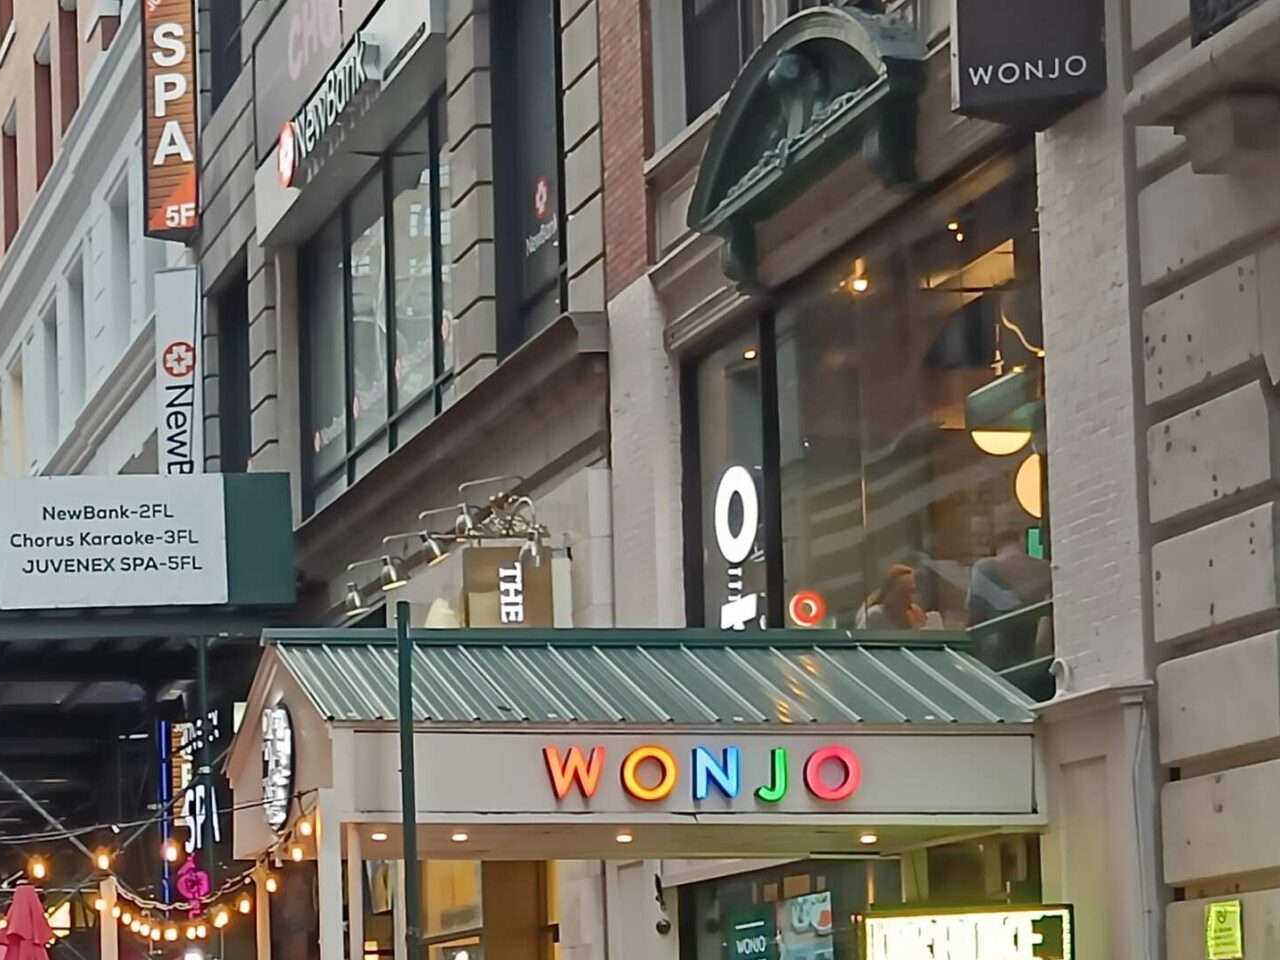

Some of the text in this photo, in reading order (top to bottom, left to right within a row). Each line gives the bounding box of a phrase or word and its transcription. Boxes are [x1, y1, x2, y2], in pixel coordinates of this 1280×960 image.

[968, 55, 1087, 86] WONJO
[152, 23, 193, 166] SPA
[294, 31, 368, 159] NewBank
[42, 504, 175, 521] NewBank-2FL
[10, 530, 199, 548] Chorus Karaoke-3FL
[22, 556, 203, 574] JUVENEX SPA-5FL
[499, 562, 524, 623] THE
[542, 744, 862, 801] WONJO
[736, 935, 766, 955] WONJO
